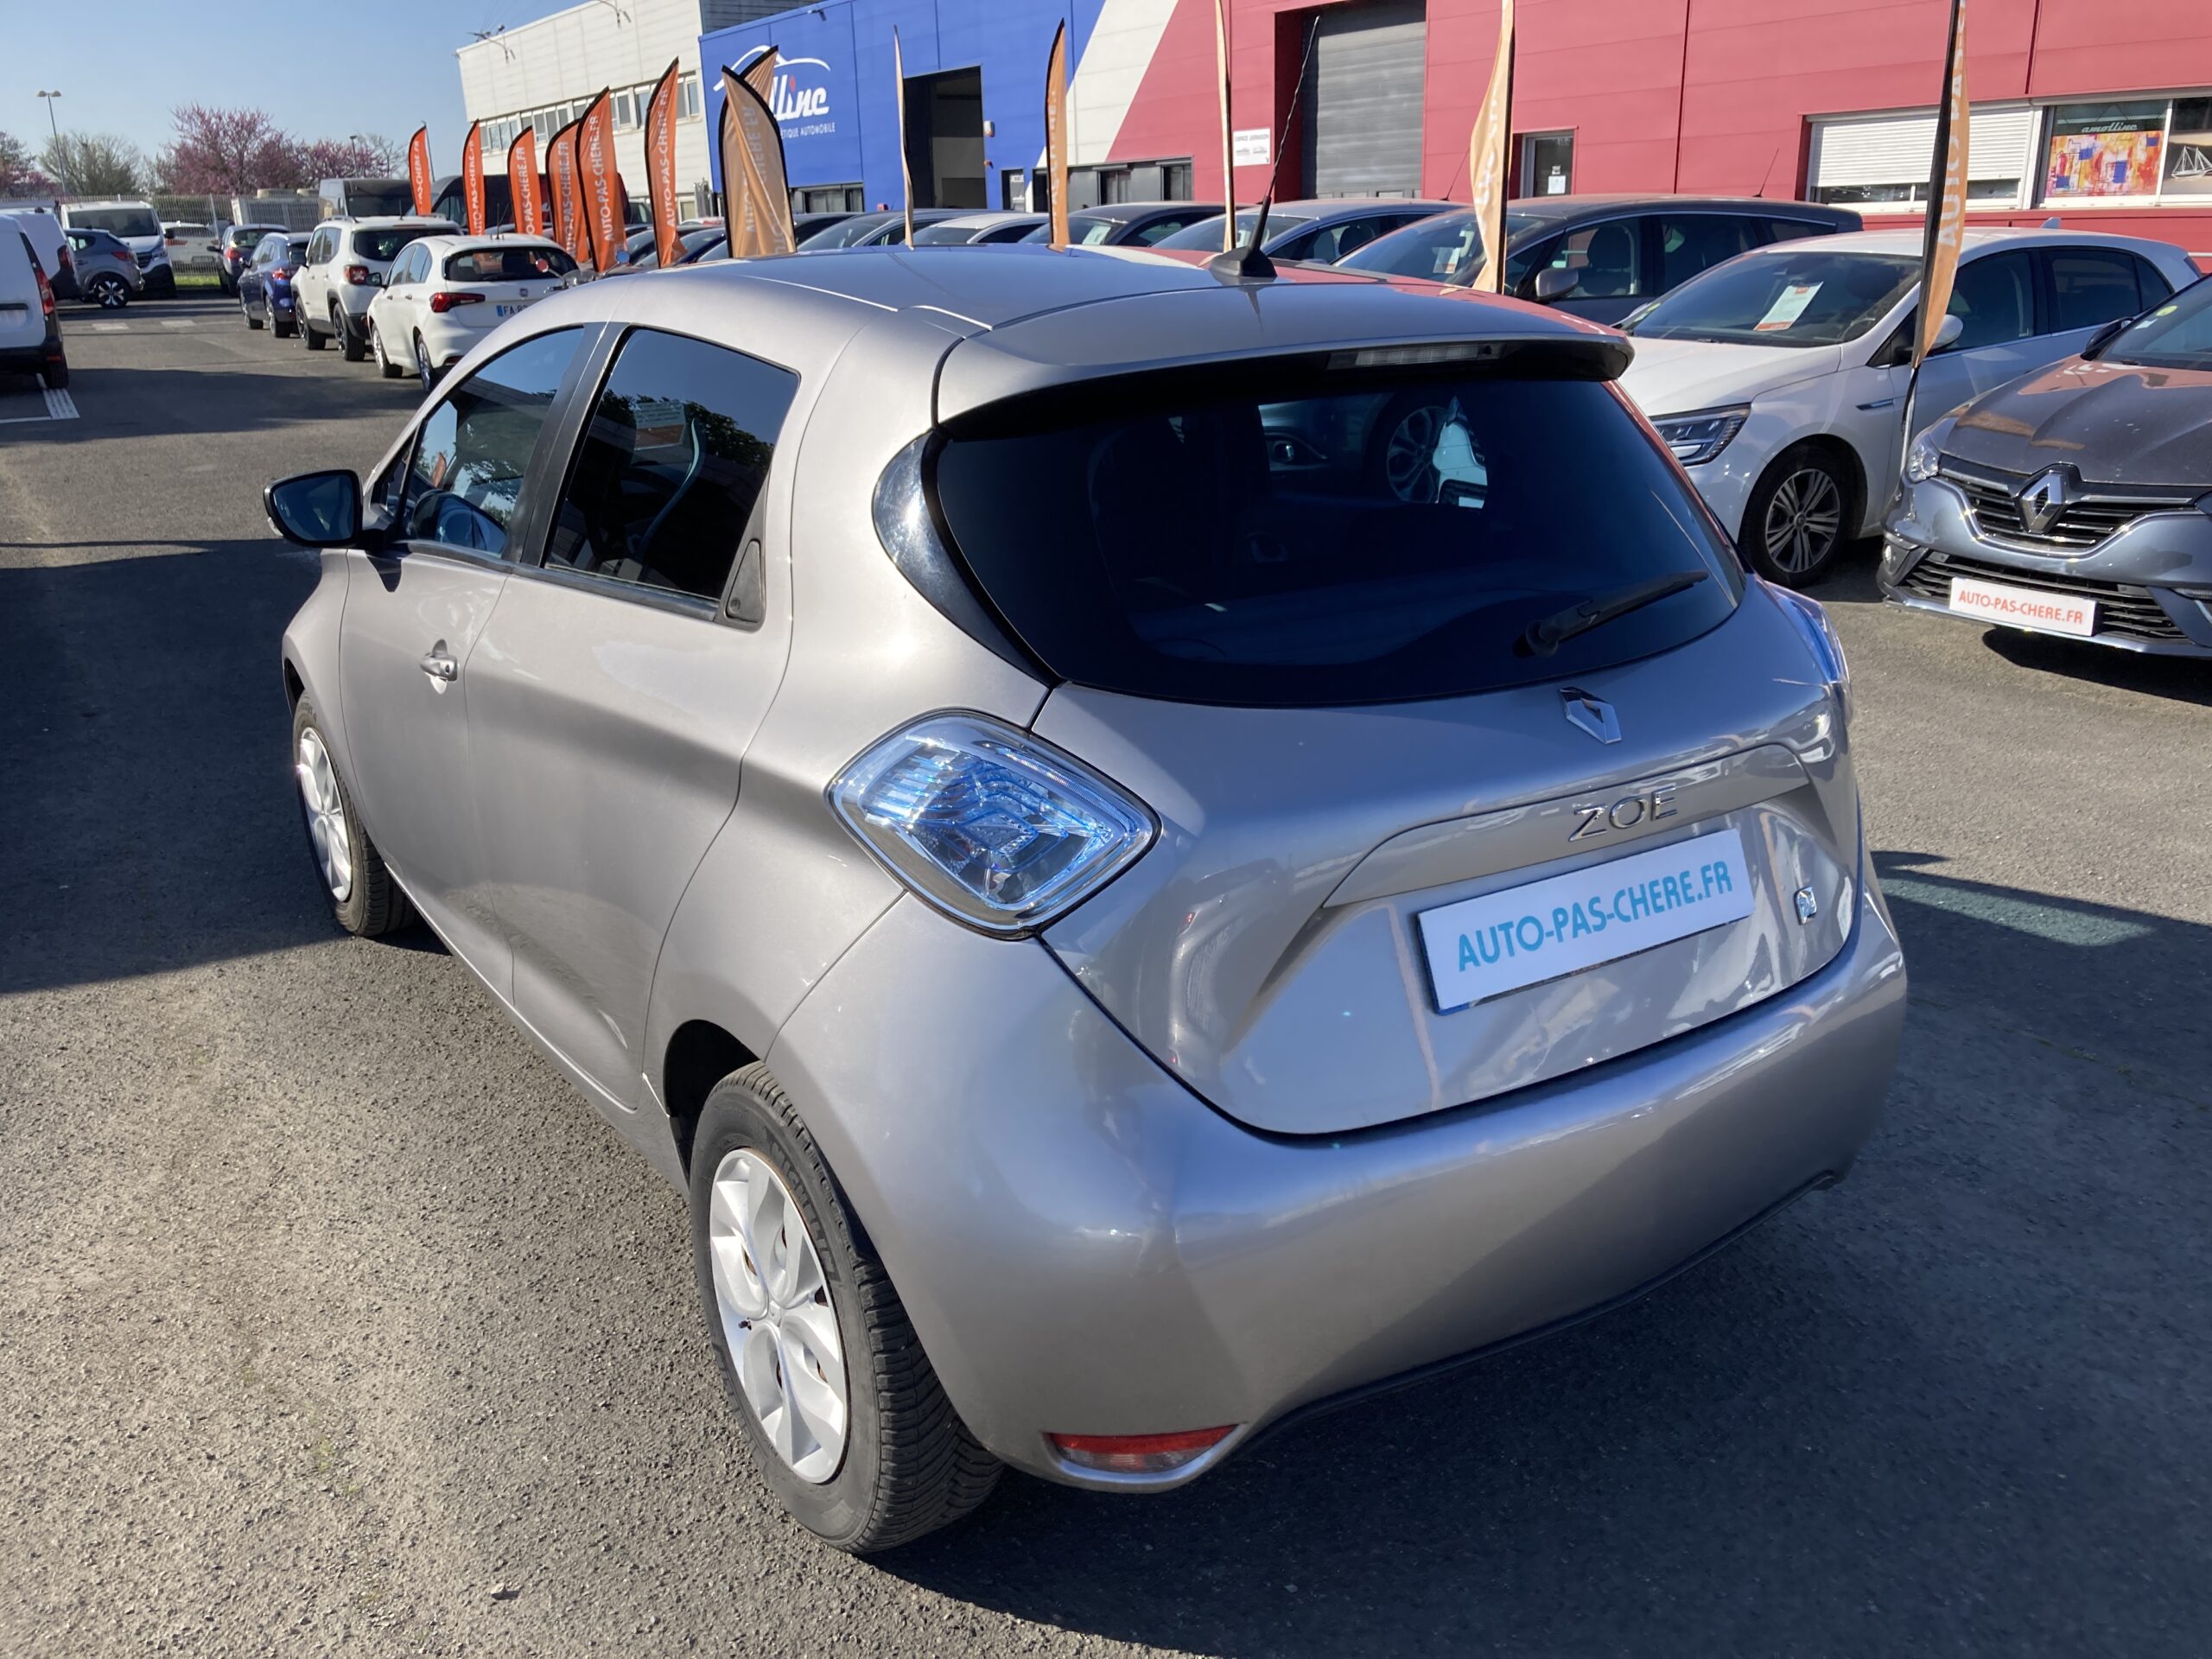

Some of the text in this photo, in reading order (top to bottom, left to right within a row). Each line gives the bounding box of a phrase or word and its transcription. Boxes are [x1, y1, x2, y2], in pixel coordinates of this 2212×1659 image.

[800, 122, 836, 137] AUTOMOBILE
[589, 115, 614, 242] AUTO-PAS-CHERE.FR
[1959, 590, 2083, 624] AUTO-PAS-CHERE.FR
[1568, 785, 1678, 842] ZOE
[1458, 860, 1732, 972] AUTO-PAS-CHERE.FR
